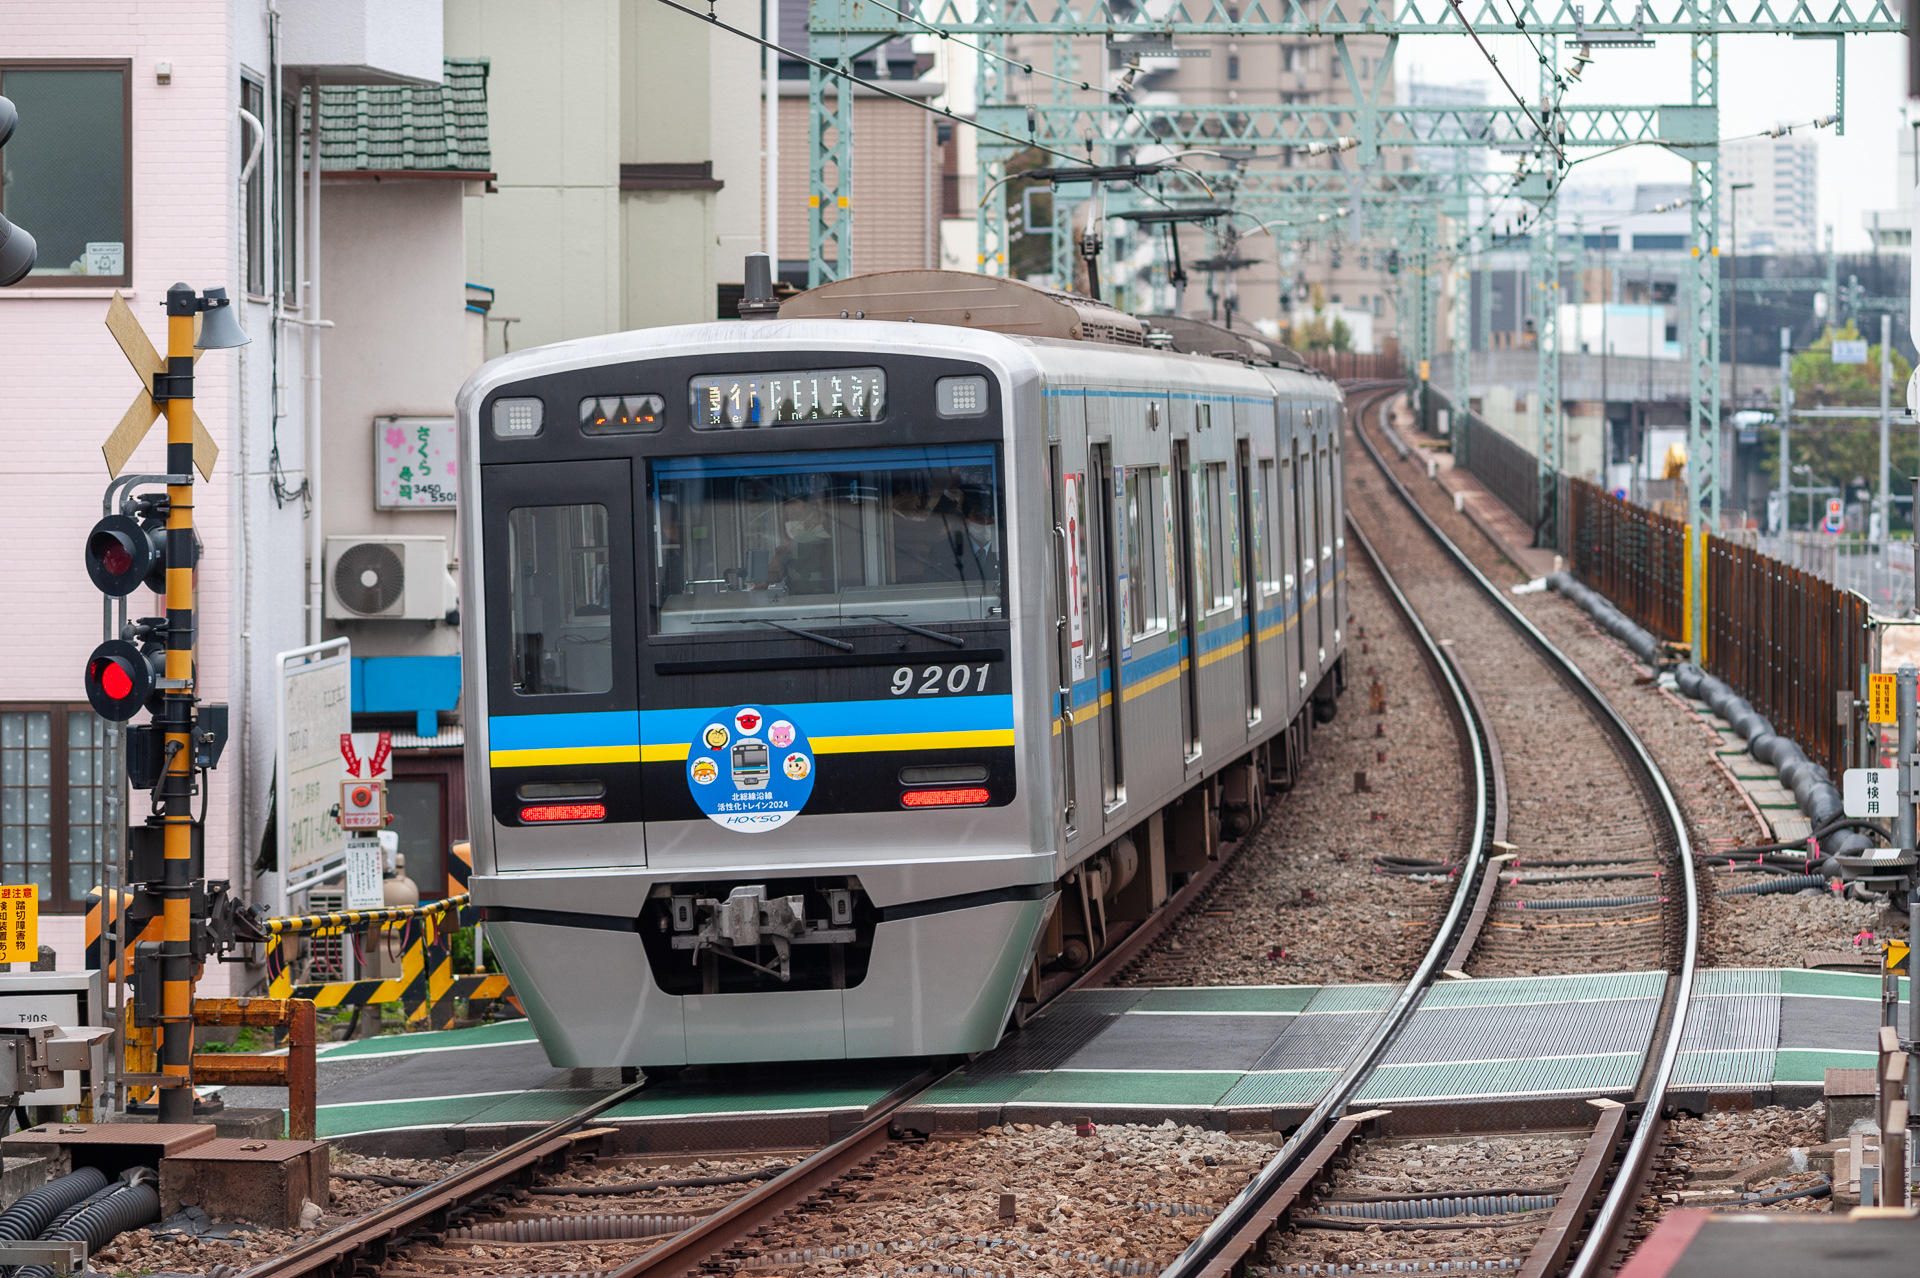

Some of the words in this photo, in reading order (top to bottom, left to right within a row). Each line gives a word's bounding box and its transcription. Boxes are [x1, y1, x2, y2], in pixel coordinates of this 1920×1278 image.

[417, 426, 431, 476] さくら
[414, 484, 441, 494] 3450
[890, 663, 990, 696] 9201
[731, 791, 774, 802] 北総線沿線
[1867, 771, 1880, 814] 障検用
[717, 800, 789, 812] 活性化トレイン2024
[1, 888, 32, 899] 避注意
[15, 901, 26, 951] 踏切障害物
